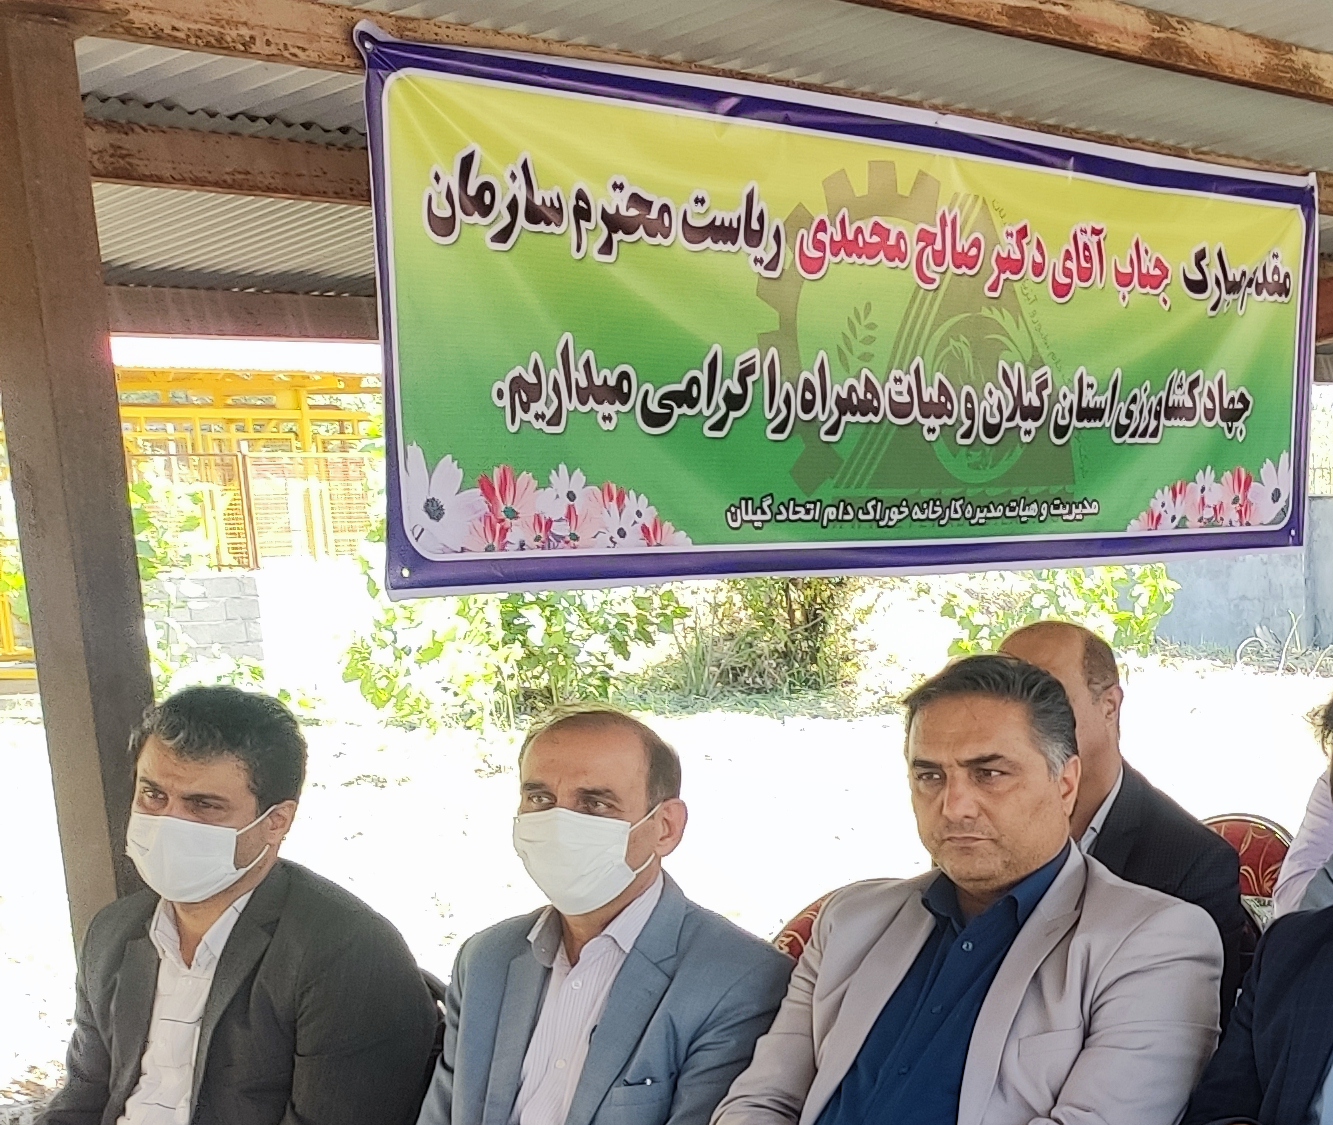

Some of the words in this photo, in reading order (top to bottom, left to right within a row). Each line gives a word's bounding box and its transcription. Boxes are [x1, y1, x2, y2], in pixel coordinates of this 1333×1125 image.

[424, 144, 565, 249] سازمان
[571, 175, 677, 262] محترم
[681, 180, 784, 277] ریاست
[797, 207, 908, 279] محمدی
[914, 207, 986, 290] صالح
[985, 219, 1047, 297] دکتر
[1050, 226, 1106, 302] آقای
[1113, 234, 1172, 311] جناب
[636, 344, 760, 436] گرامی
[763, 347, 796, 441] را
[797, 349, 884, 441] همراه
[885, 356, 958, 443] هیات
[956, 382, 978, 444] و
[979, 359, 1050, 444] گیلان
[1049, 365, 1121, 445] استان
[1112, 367, 1203, 443] کشاورزی
[1200, 367, 1252, 443] جهاد
[725, 493, 774, 530] گیلان
[775, 498, 822, 522] اتحاد
[821, 498, 855, 528] دام
[857, 497, 911, 528] خوراک
[911, 496, 965, 527] کارخانه
[964, 500, 1004, 526] مدیره
[1005, 496, 1038, 524] هیات
[1039, 501, 1048, 523] و
[1049, 496, 1100, 522] مدیریت
